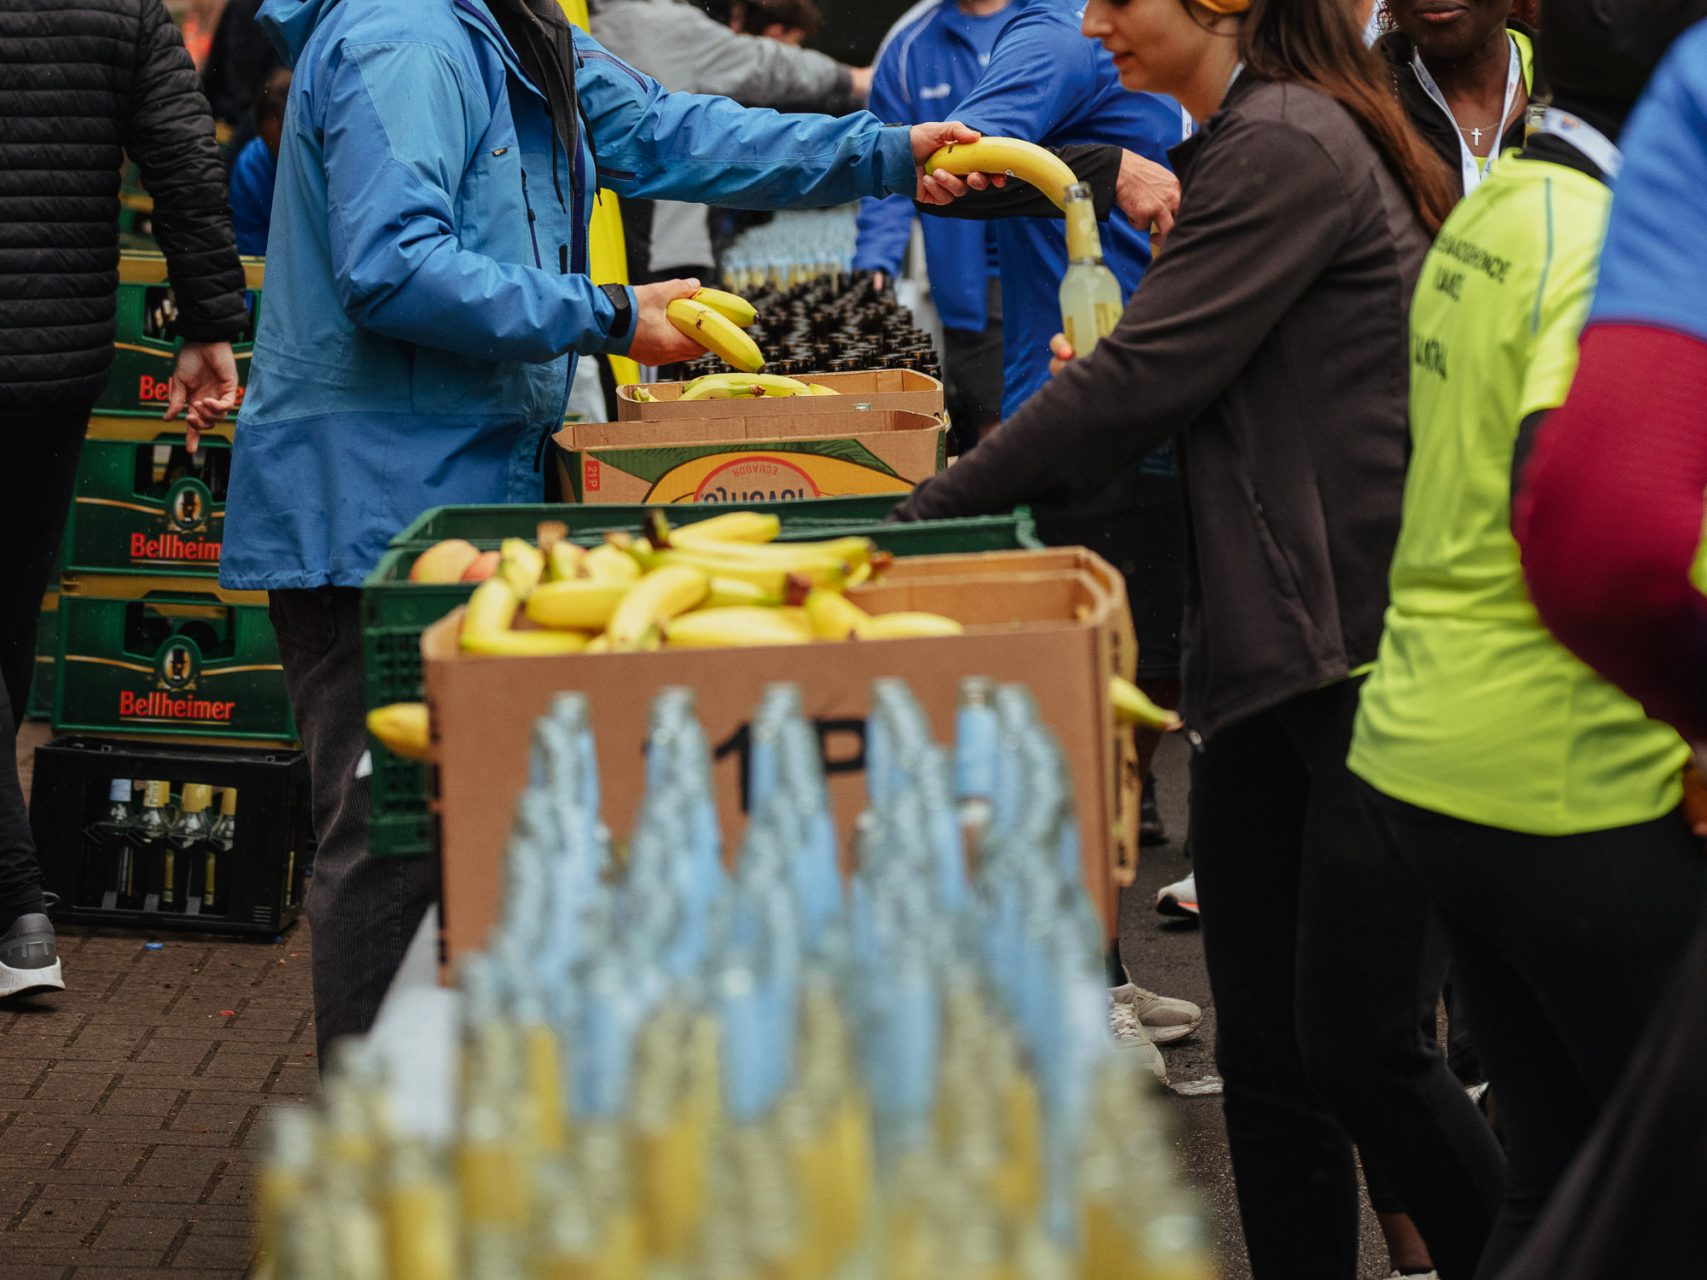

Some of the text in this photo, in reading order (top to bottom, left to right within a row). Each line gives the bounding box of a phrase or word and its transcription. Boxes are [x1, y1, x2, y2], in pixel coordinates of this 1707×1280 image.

[732, 463, 778, 477] ECUADOR
[130, 532, 222, 561] Bellheim
[120, 690, 235, 720] Bellheimer
